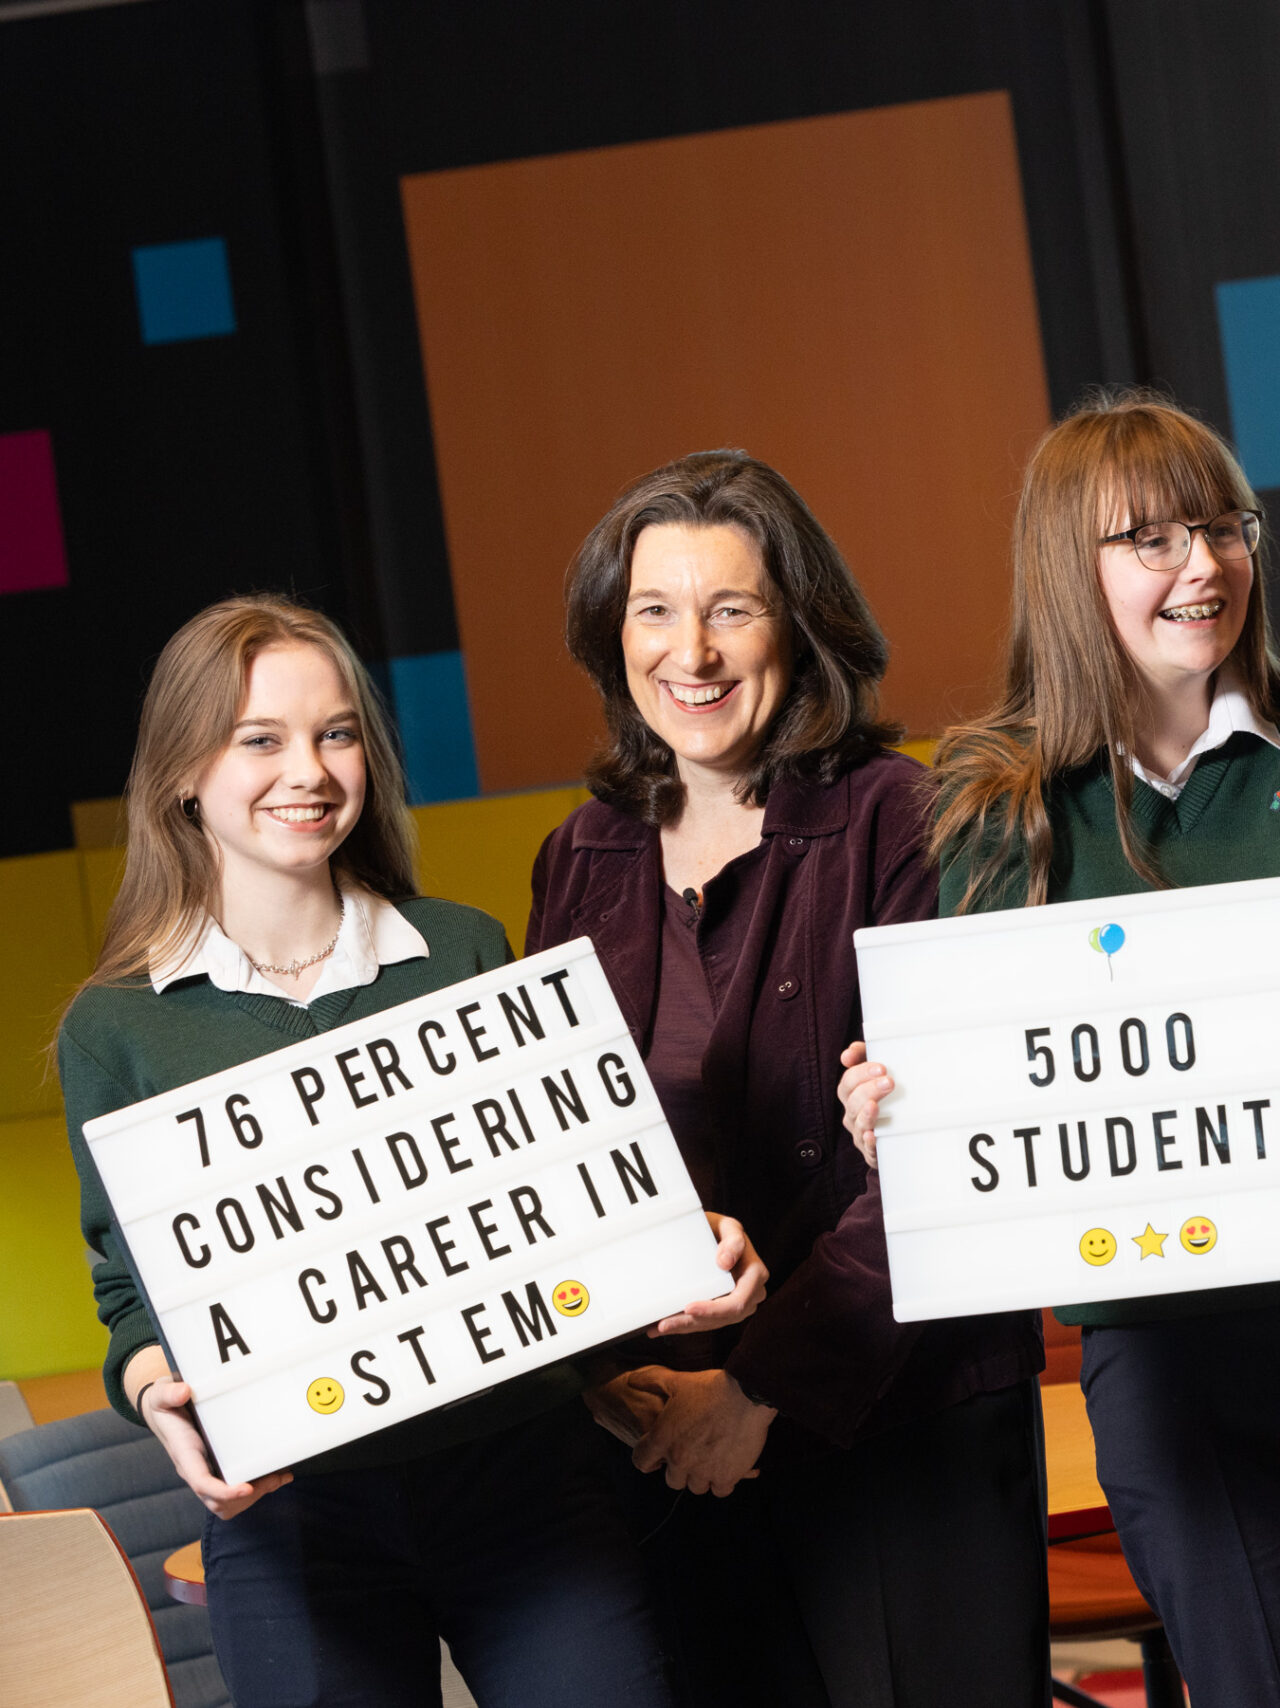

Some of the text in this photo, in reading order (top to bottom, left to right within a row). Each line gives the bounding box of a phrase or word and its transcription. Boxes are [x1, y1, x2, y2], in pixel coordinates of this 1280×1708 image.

[176, 969, 579, 1167] 76 PERCENT
[1025, 1013, 1195, 1087] 5000
[173, 1053, 636, 1268] CONSIDERING
[210, 1142, 658, 1363] A CAREER IN
[351, 1281, 557, 1406] STEM
